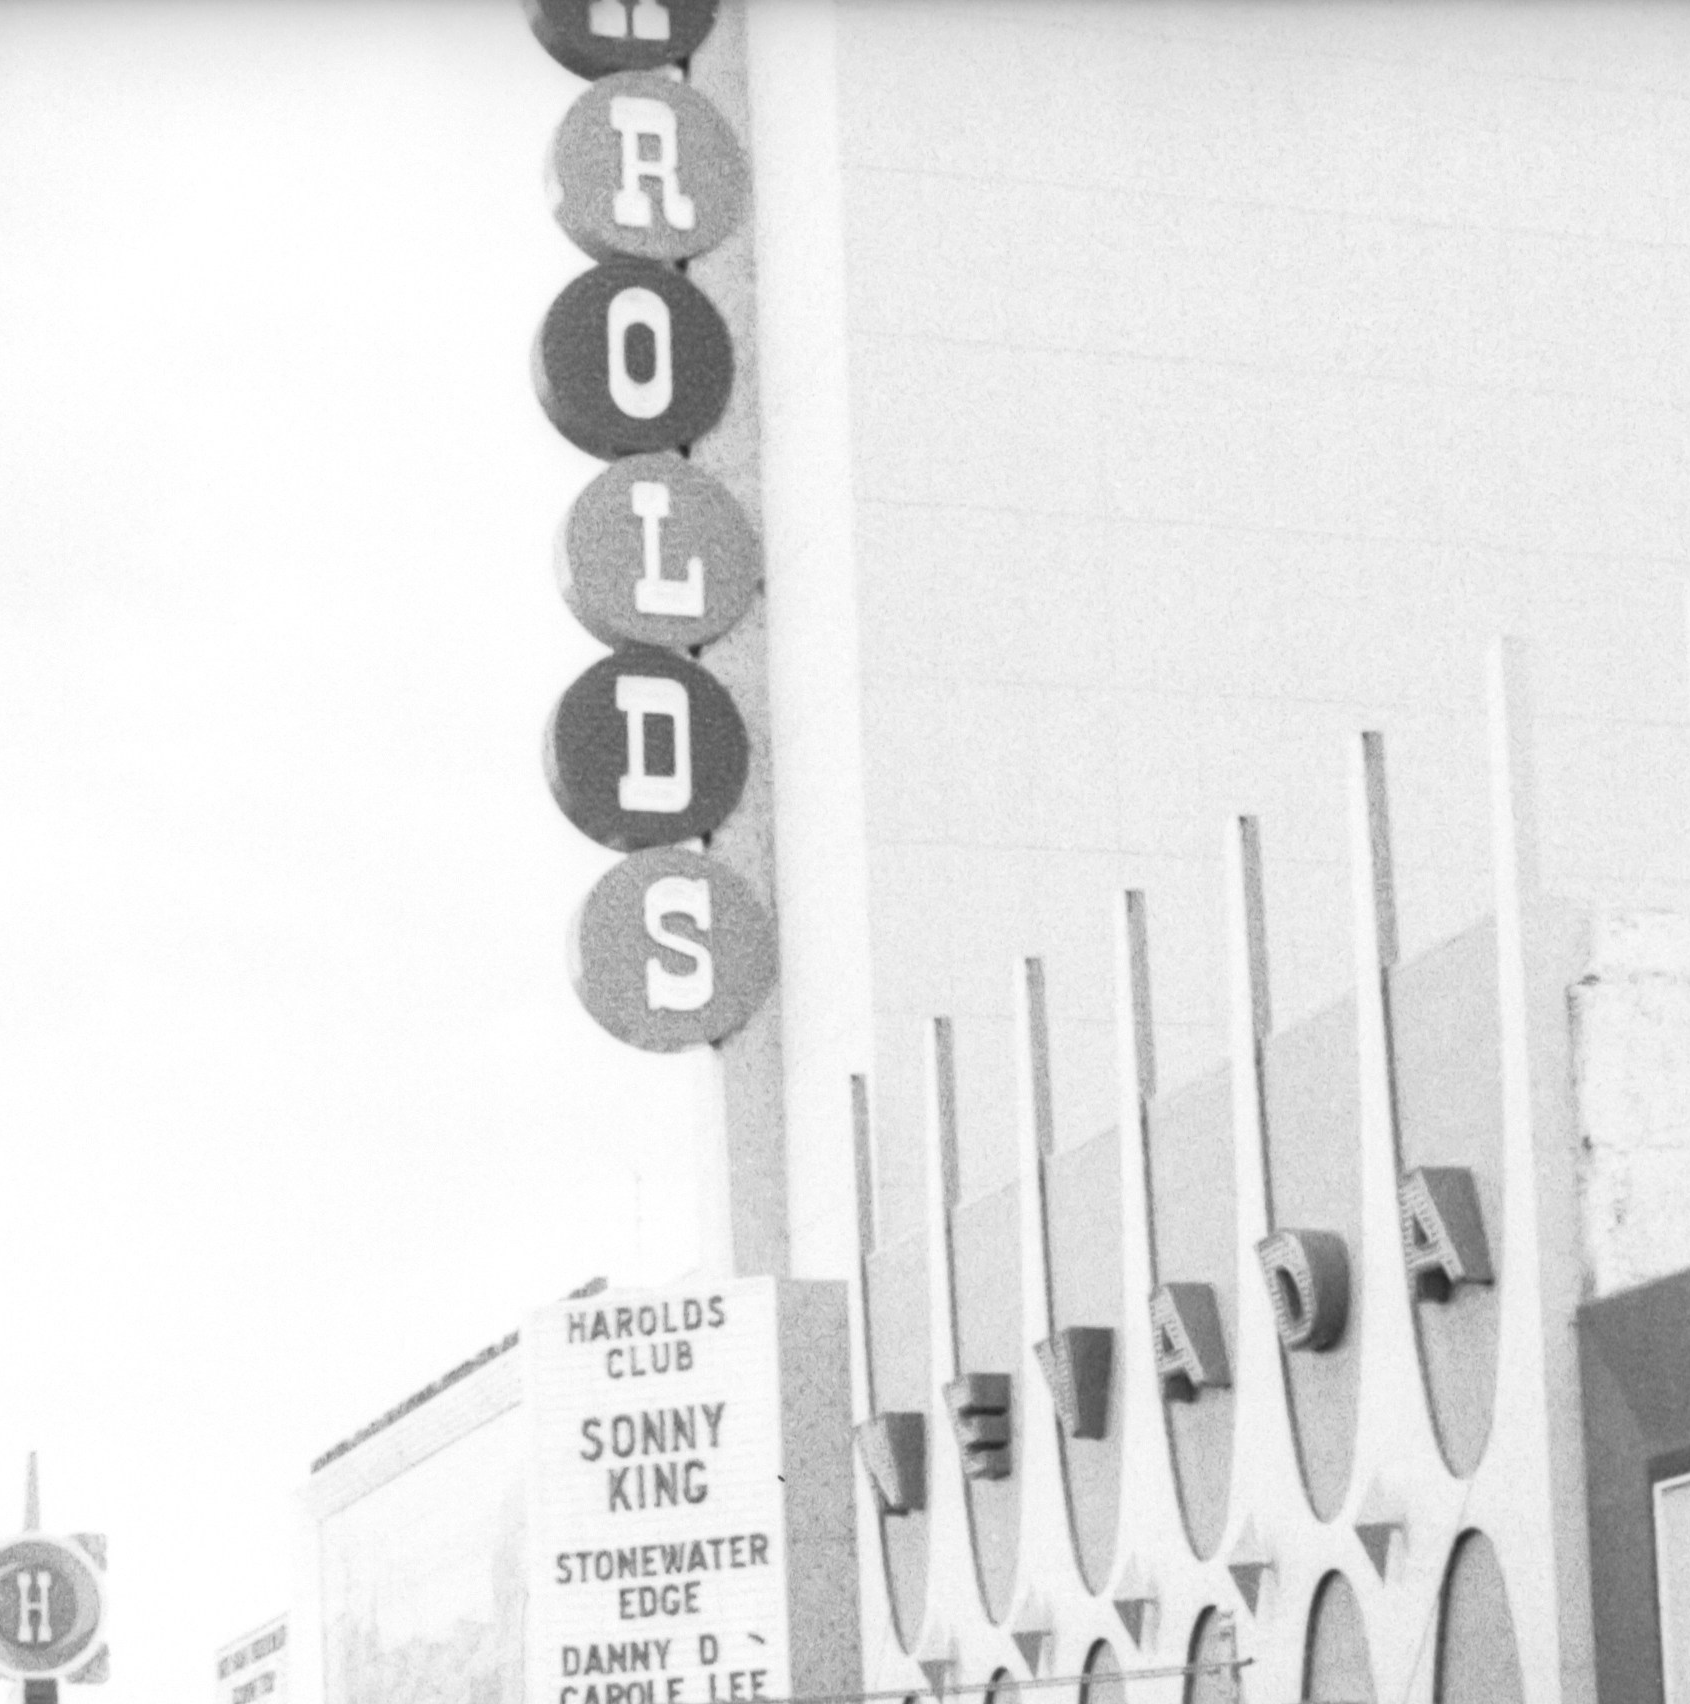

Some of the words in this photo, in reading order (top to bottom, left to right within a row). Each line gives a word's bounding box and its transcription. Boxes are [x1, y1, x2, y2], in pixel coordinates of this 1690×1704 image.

[586, 0, 715, 1011] ROLDS
[567, 1296, 726, 1343] HAROLDS
[606, 1339, 694, 1379] CLUB
[580, 1402, 726, 1462] SONNY
[608, 1460, 708, 1512] KING
[556, 1533, 769, 1584] STONEWATER
[618, 1582, 702, 1619] EDGE
[562, 1639, 671, 1677] DANNY
[699, 1633, 719, 1665] D
[709, 1670, 768, 1702] LEE
